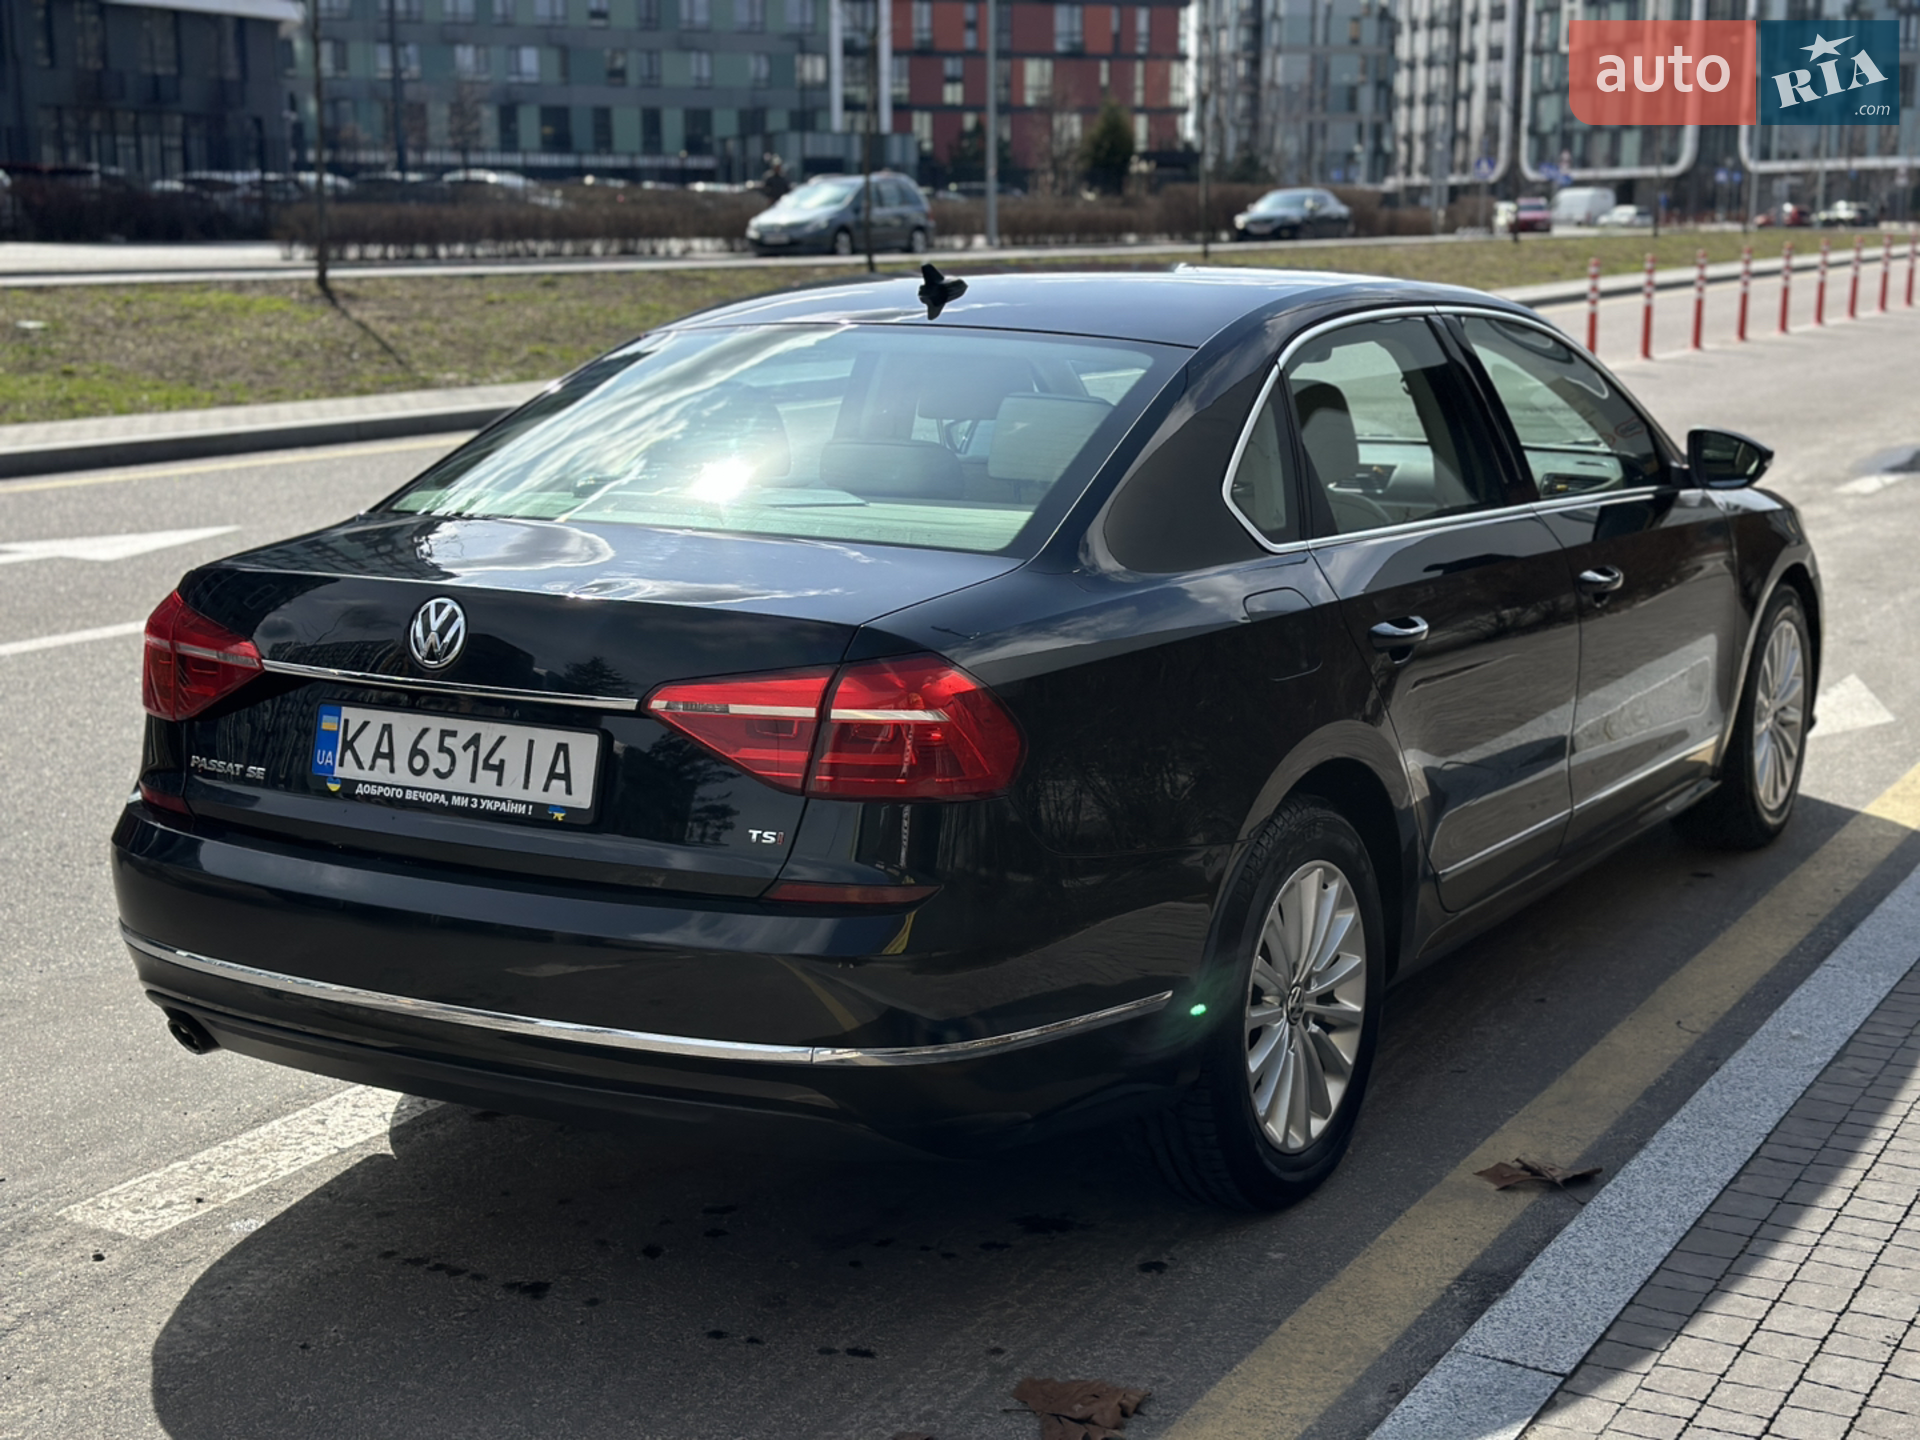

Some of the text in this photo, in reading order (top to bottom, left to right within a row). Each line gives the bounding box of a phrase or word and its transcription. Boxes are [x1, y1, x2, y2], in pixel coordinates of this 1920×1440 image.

[190, 755, 266, 780] PASSAT SE
[316, 750, 334, 767] UA
[407, 727, 508, 787] 6514
[355, 783, 404, 799] ДОБРОГО
[405, 789, 449, 807] ВЕЧОРА,
[451, 795, 469, 808] МИ
